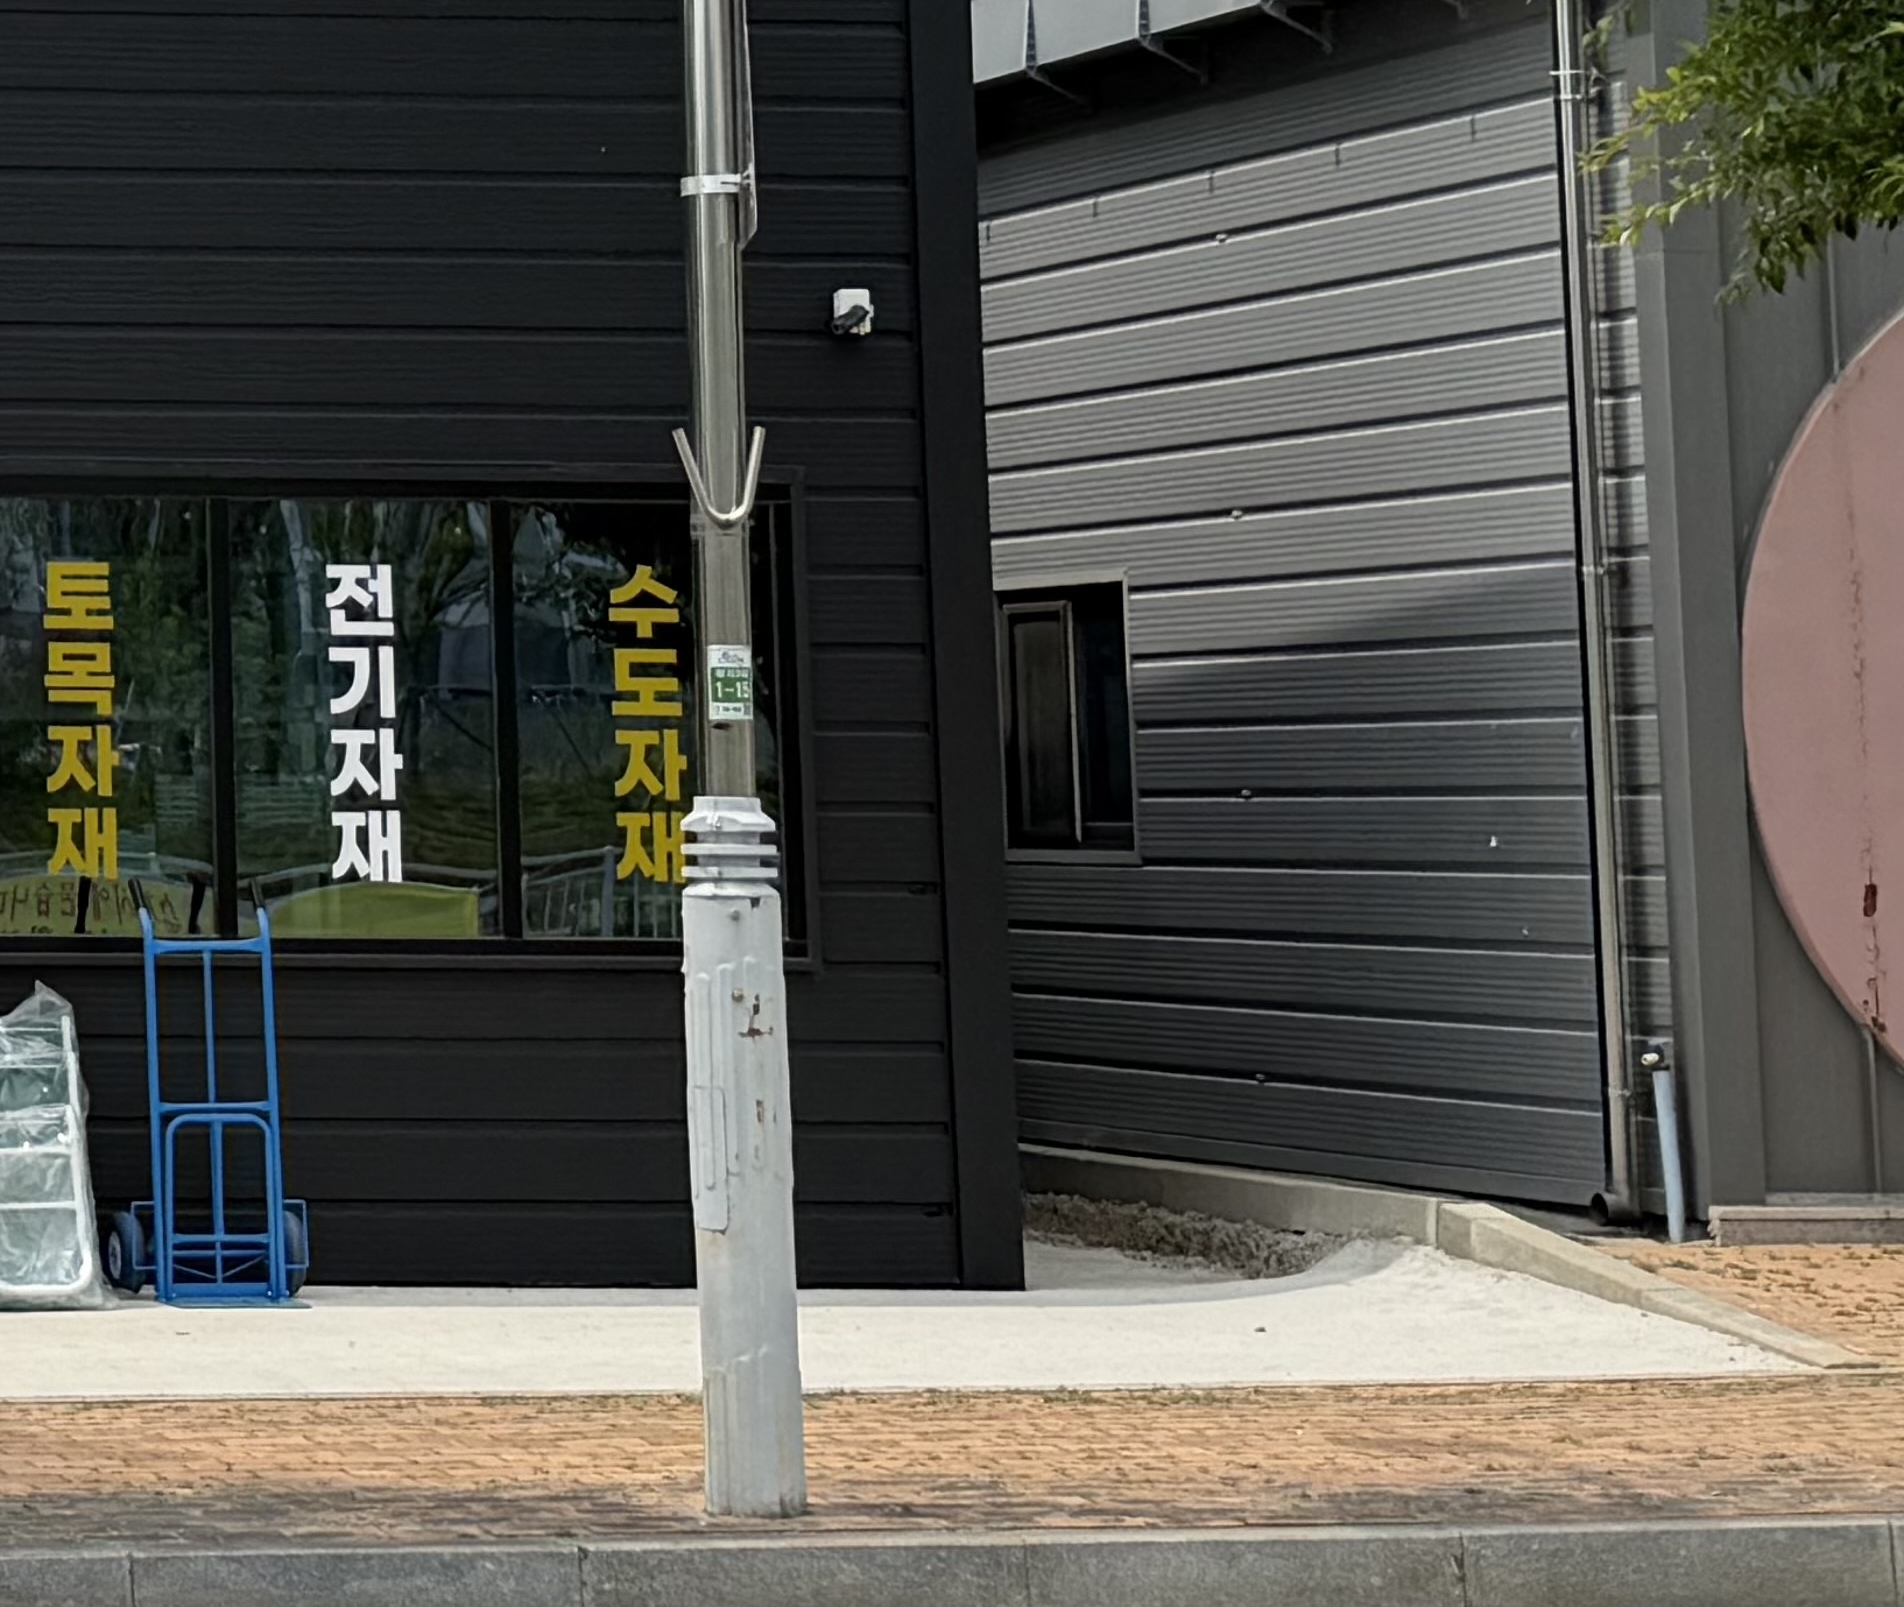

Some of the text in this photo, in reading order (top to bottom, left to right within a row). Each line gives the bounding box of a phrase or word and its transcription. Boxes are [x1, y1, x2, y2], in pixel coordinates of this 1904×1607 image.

[43, 561, 120, 880] 토목자재
[325, 564, 404, 883] 전기자재
[608, 564, 687, 884] 수도자재
